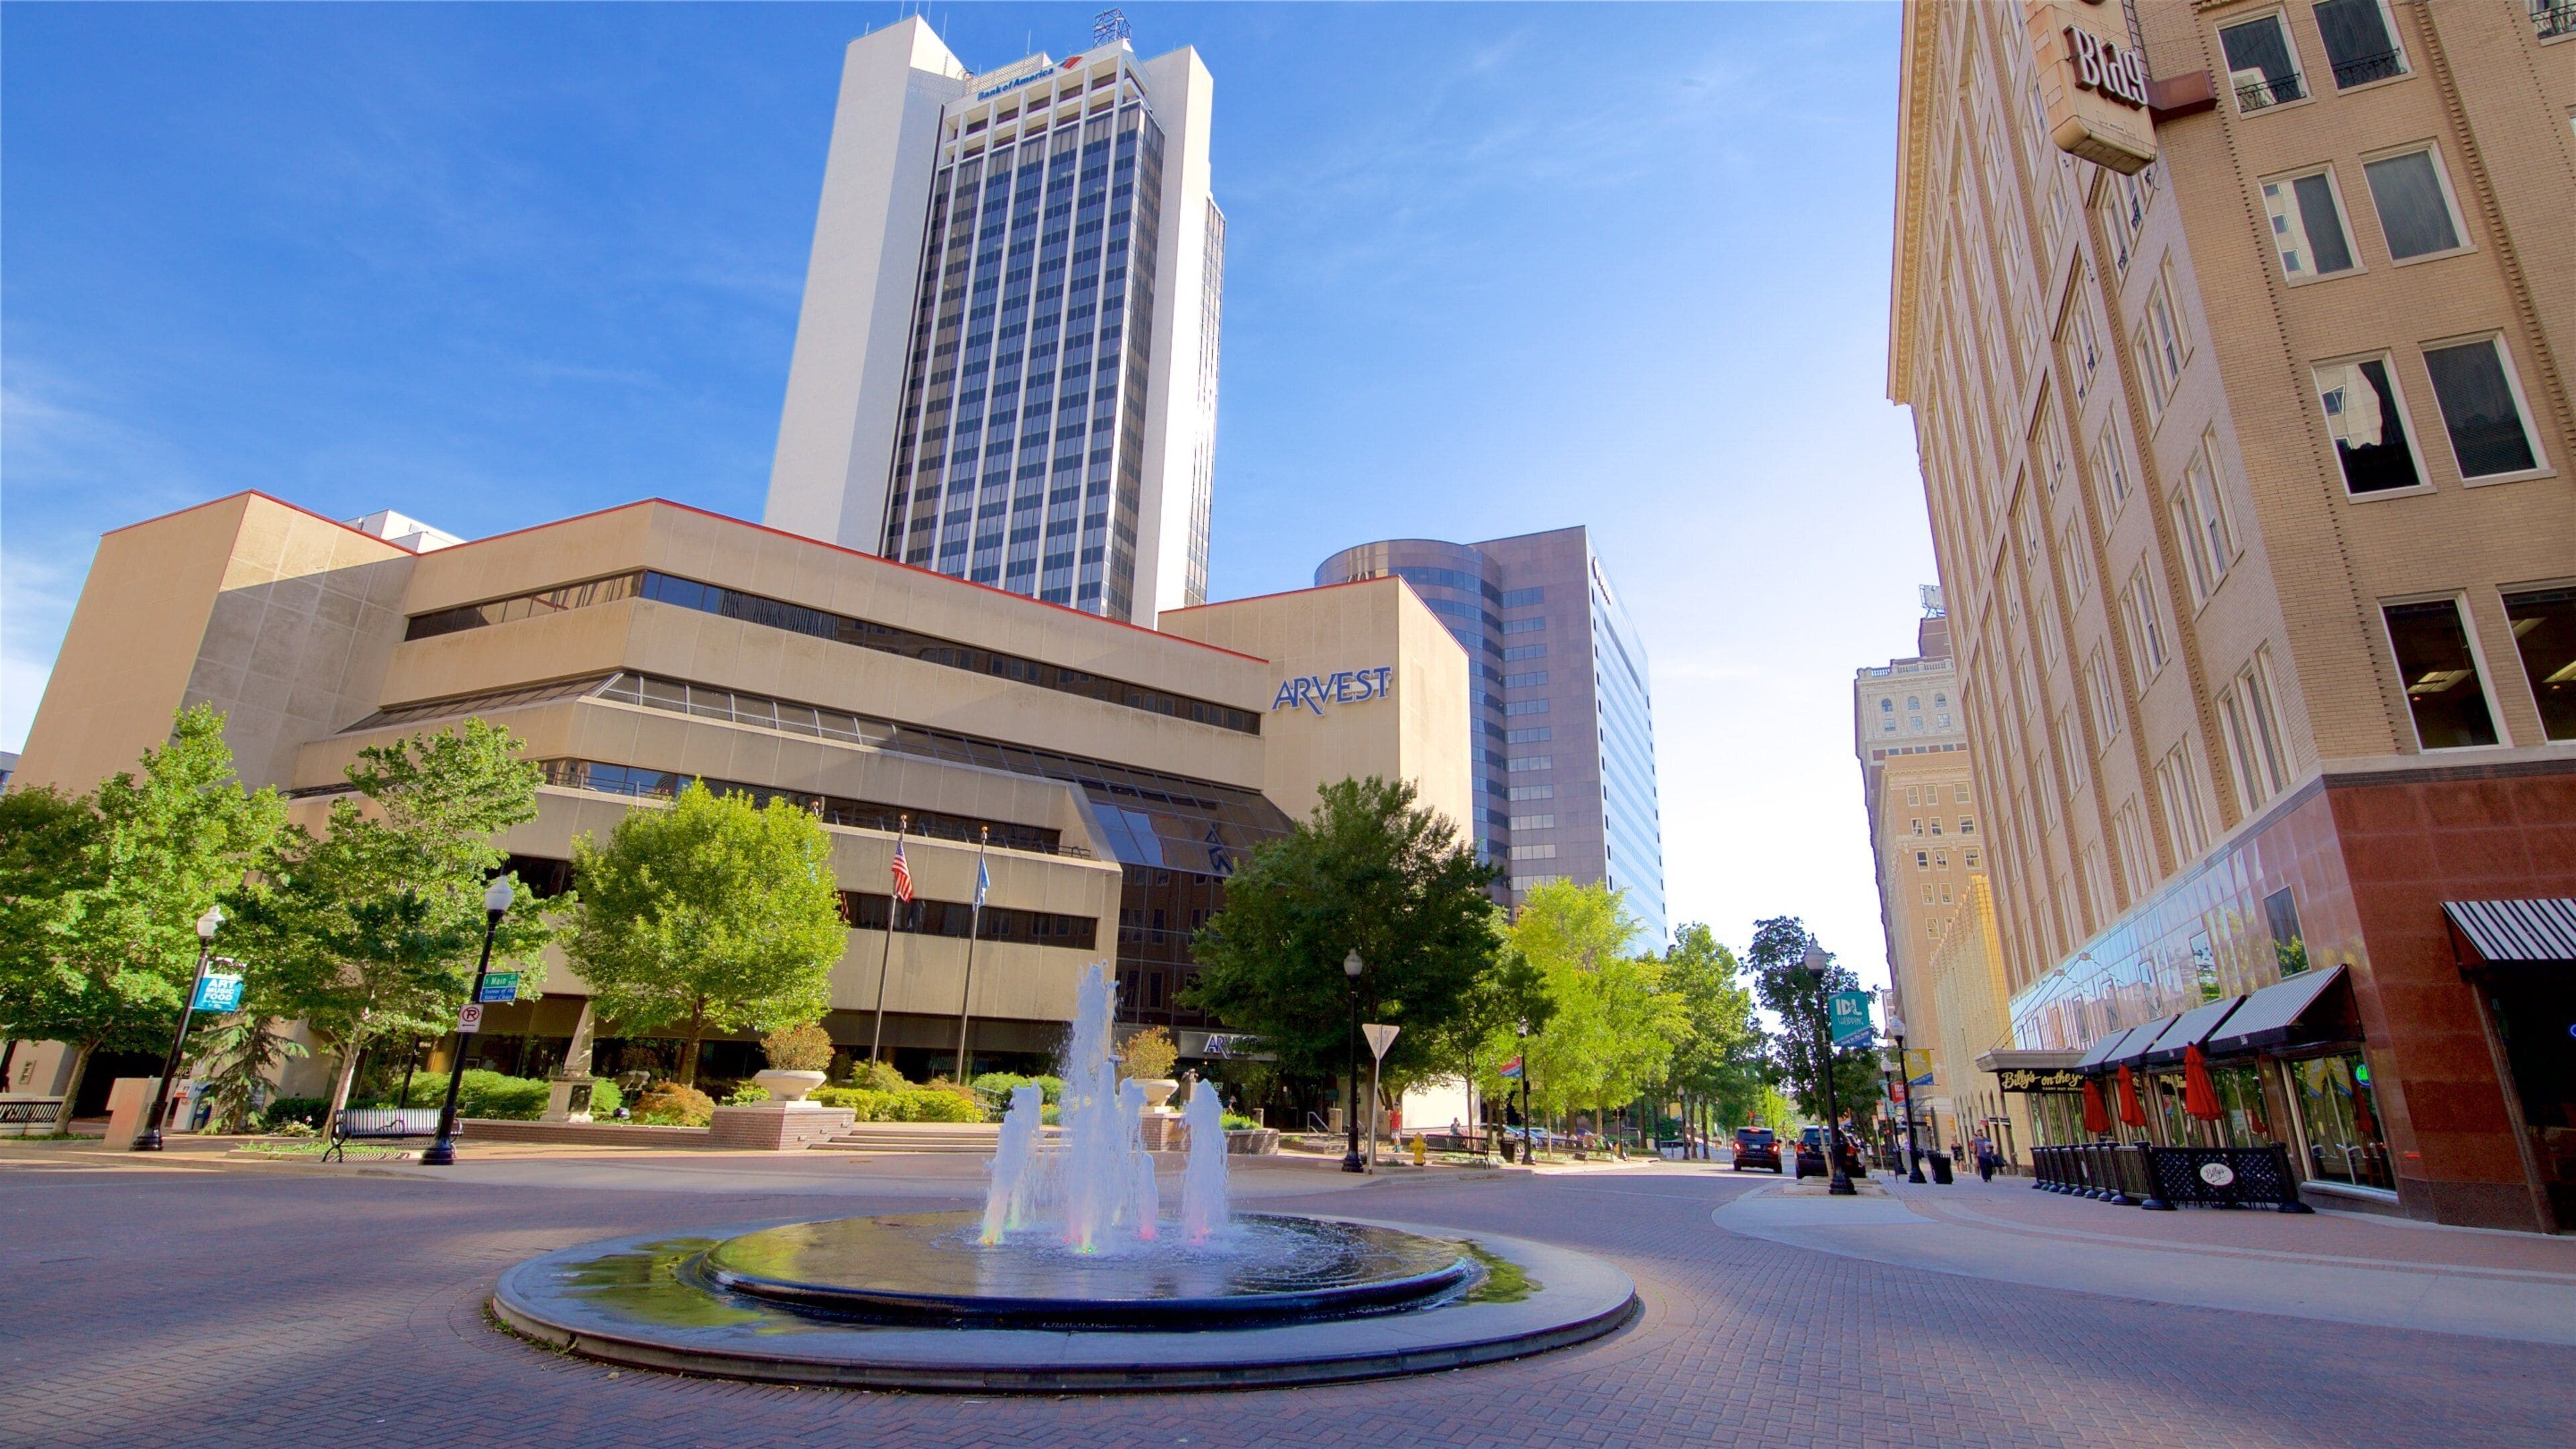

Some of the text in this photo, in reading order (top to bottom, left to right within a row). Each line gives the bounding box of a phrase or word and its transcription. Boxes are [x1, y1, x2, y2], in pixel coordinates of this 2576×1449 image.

[2063, 24, 2148, 108] Bldg
[977, 68, 1054, 101] Bank of America
[1272, 666, 1391, 716] ARVEST
[207, 979, 237, 989] ART
[490, 977, 507, 985] Main
[203, 992, 233, 1001] FOOD
[2001, 1069, 2041, 1089] Billy's
[2041, 1075, 2054, 1085] on
[2054, 1069, 2071, 1084] the
